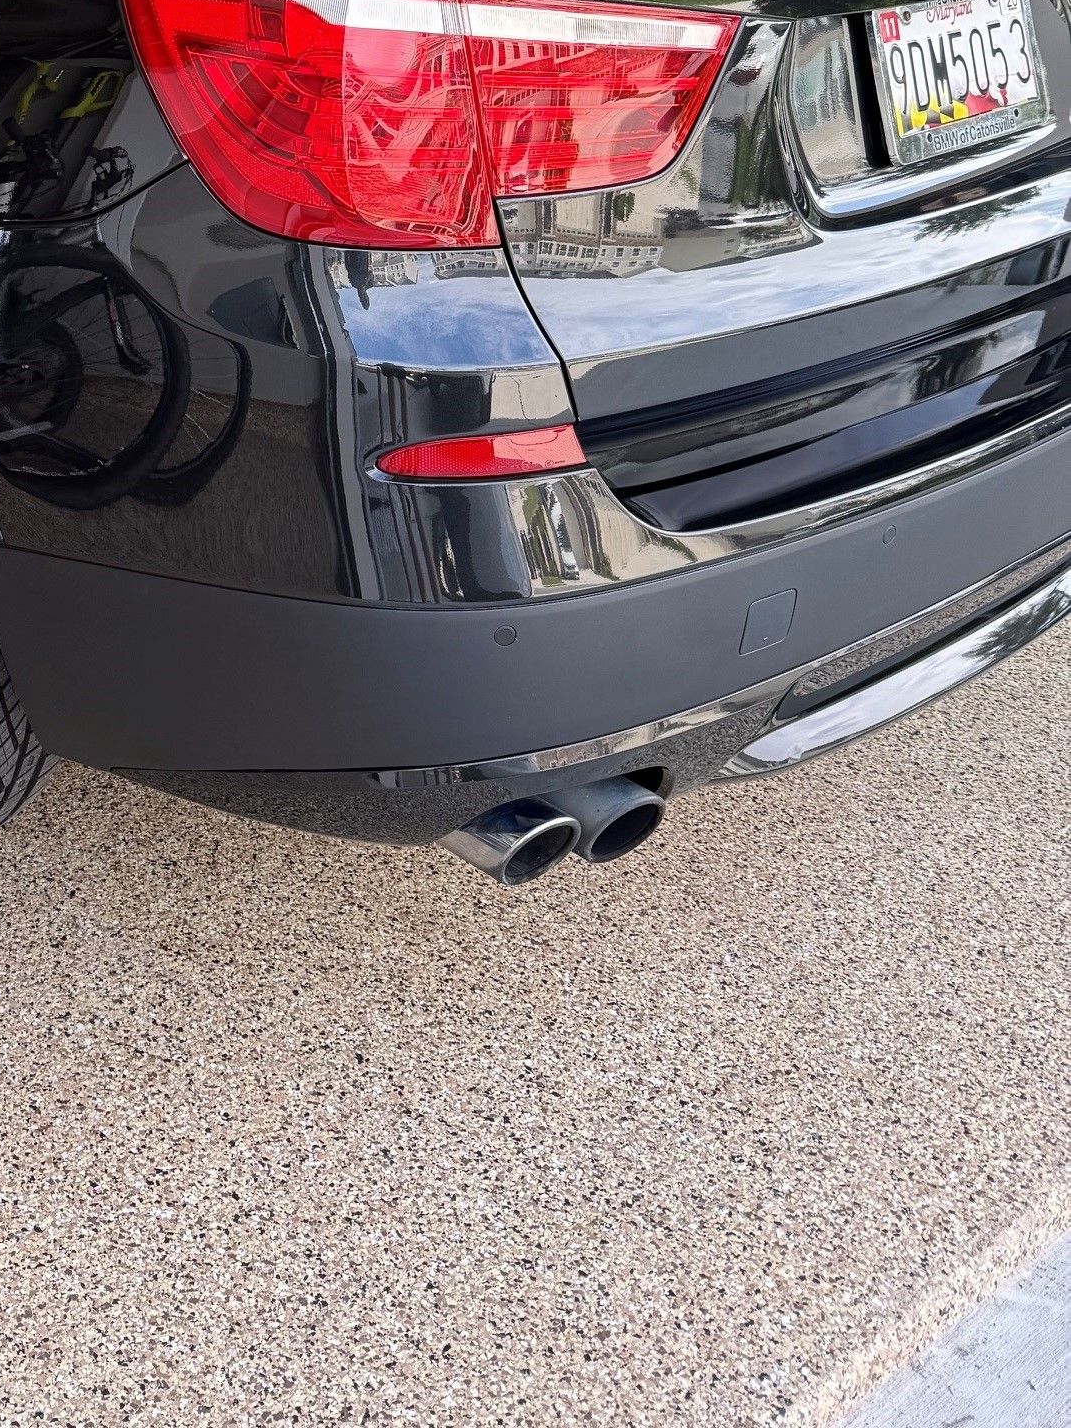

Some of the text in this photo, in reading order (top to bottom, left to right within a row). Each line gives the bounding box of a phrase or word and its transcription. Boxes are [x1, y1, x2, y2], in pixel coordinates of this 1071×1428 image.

[927, 1, 973, 25] Maryland
[884, 18, 897, 39] 11
[889, 18, 1031, 115] 9DM5053
[934, 117, 1015, 151] BMW of Catonsville
